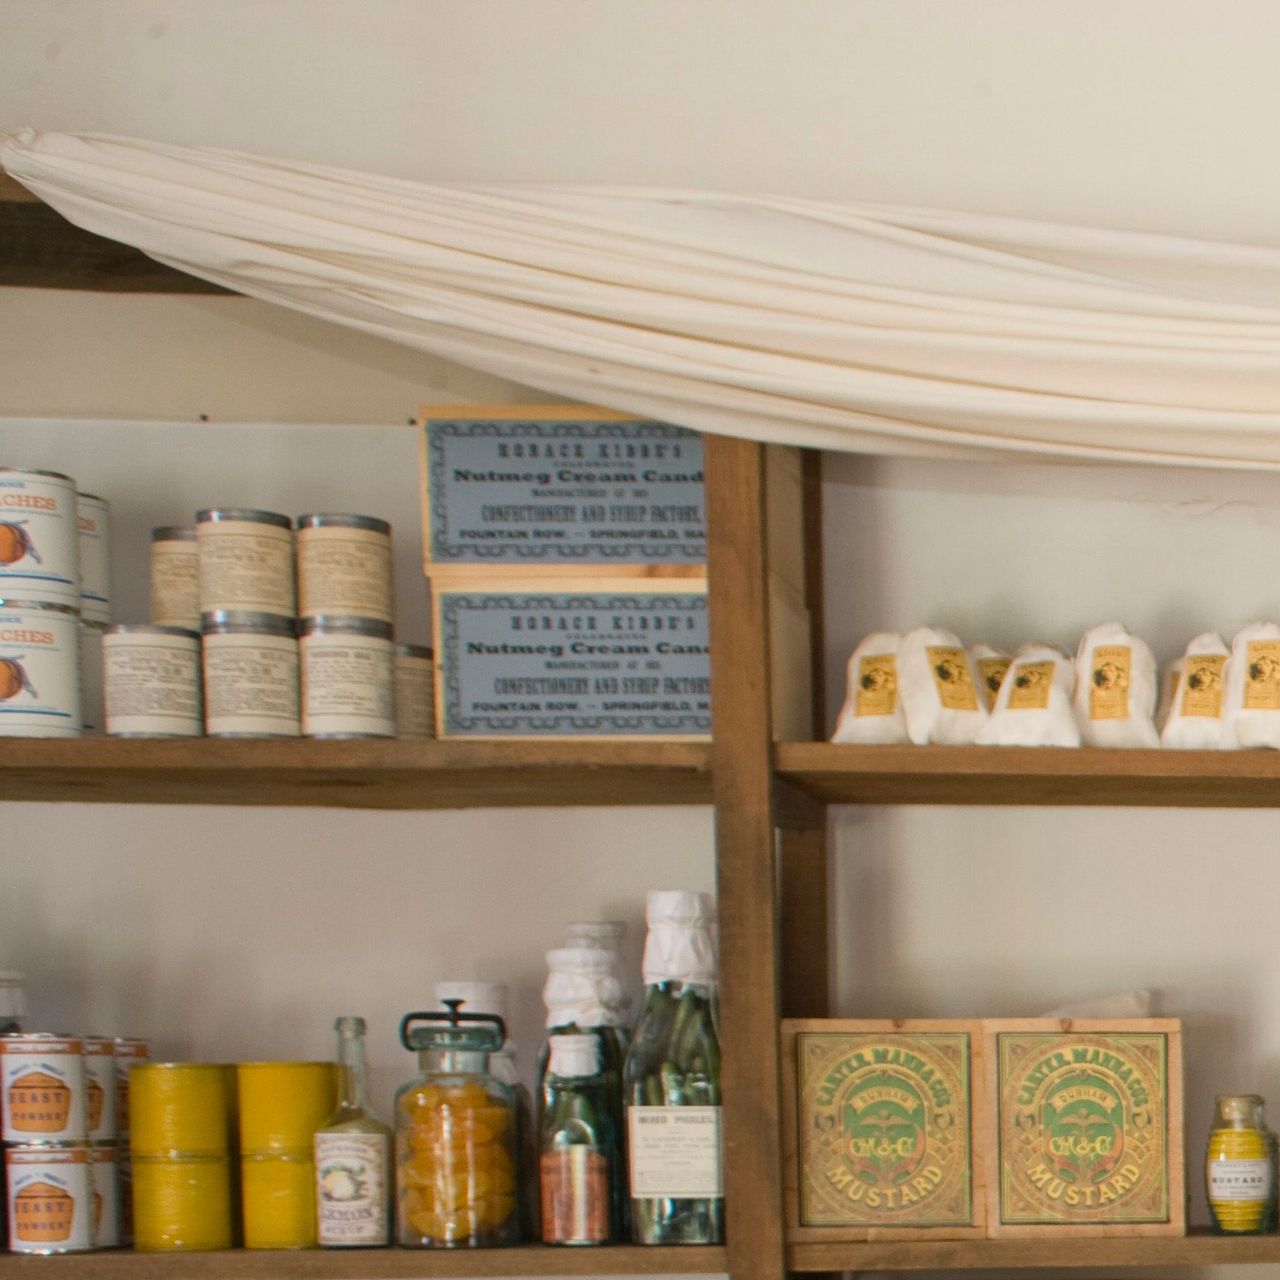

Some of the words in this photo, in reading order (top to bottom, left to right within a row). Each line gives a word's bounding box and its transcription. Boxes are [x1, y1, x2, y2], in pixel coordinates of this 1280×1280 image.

[498, 443, 585, 458] HORACE
[453, 470, 550, 484] Nutmeg
[557, 470, 636, 482] Cream
[642, 469, 705, 482] Cand
[582, 505, 605, 522] AND
[609, 505, 647, 522] SYRUP
[459, 529, 529, 539] FOUNTAIN
[511, 616, 597, 630] HORACE
[466, 642, 564, 657] Nutmeg
[570, 642, 649, 655] Cream
[595, 677, 618, 695] AND
[622, 677, 660, 695] SYRUP
[472, 702, 541, 711] FOUNTAIN
[827, 1165, 944, 1207] MUSTARD
[1027, 1163, 1143, 1206] MUSTARD
